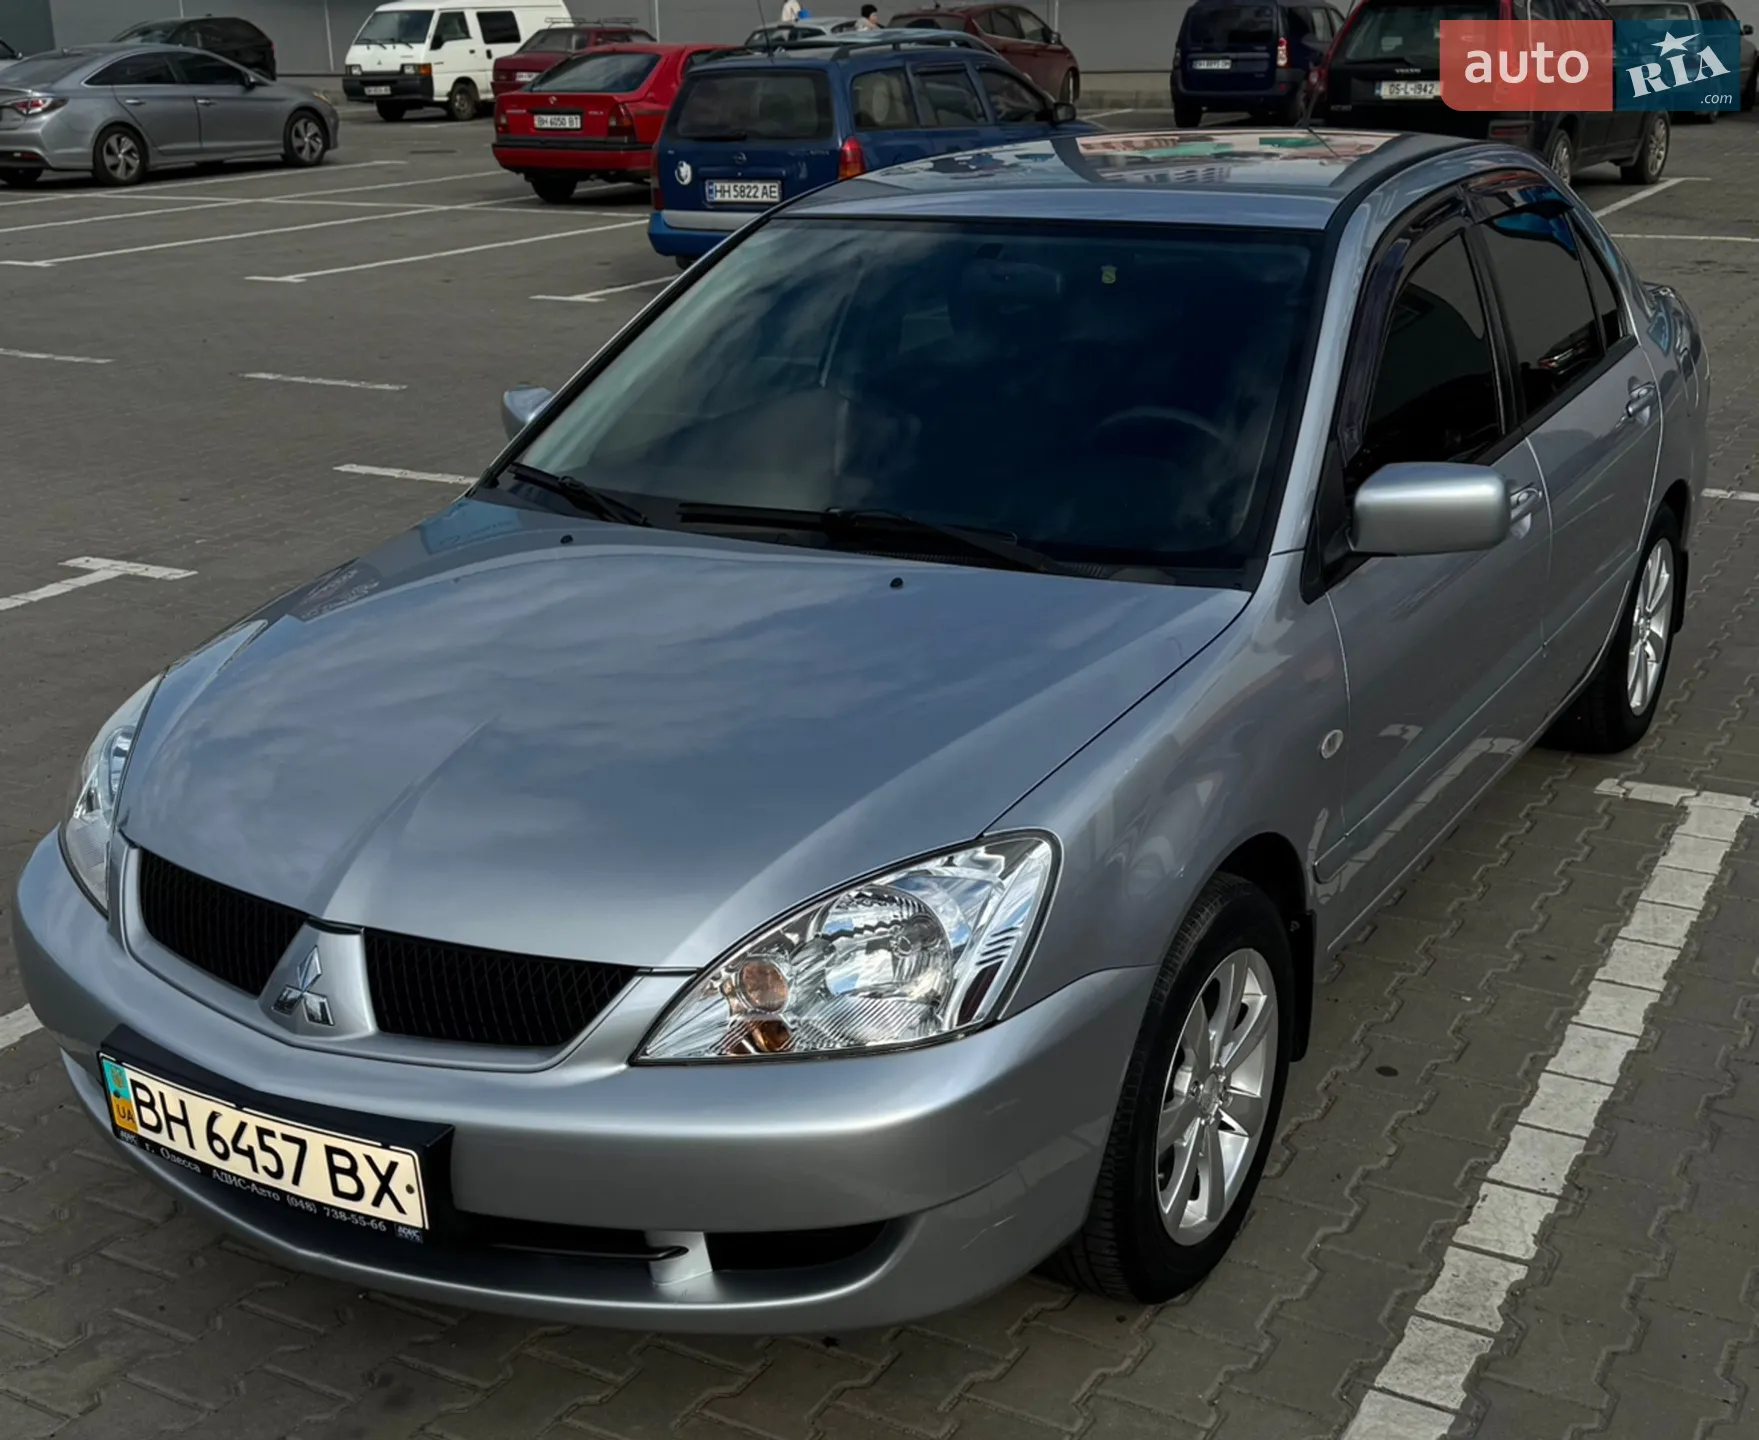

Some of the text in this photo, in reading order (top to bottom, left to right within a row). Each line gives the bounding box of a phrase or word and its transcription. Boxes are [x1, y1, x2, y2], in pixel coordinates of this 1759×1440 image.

[714, 184, 777, 199] HH 5822 AE
[116, 1104, 136, 1124] UA
[129, 1078, 407, 1216] BH 6457 BX
[160, 1147, 202, 1174] Одесса
[323, 1206, 387, 1232] 738-55-66
